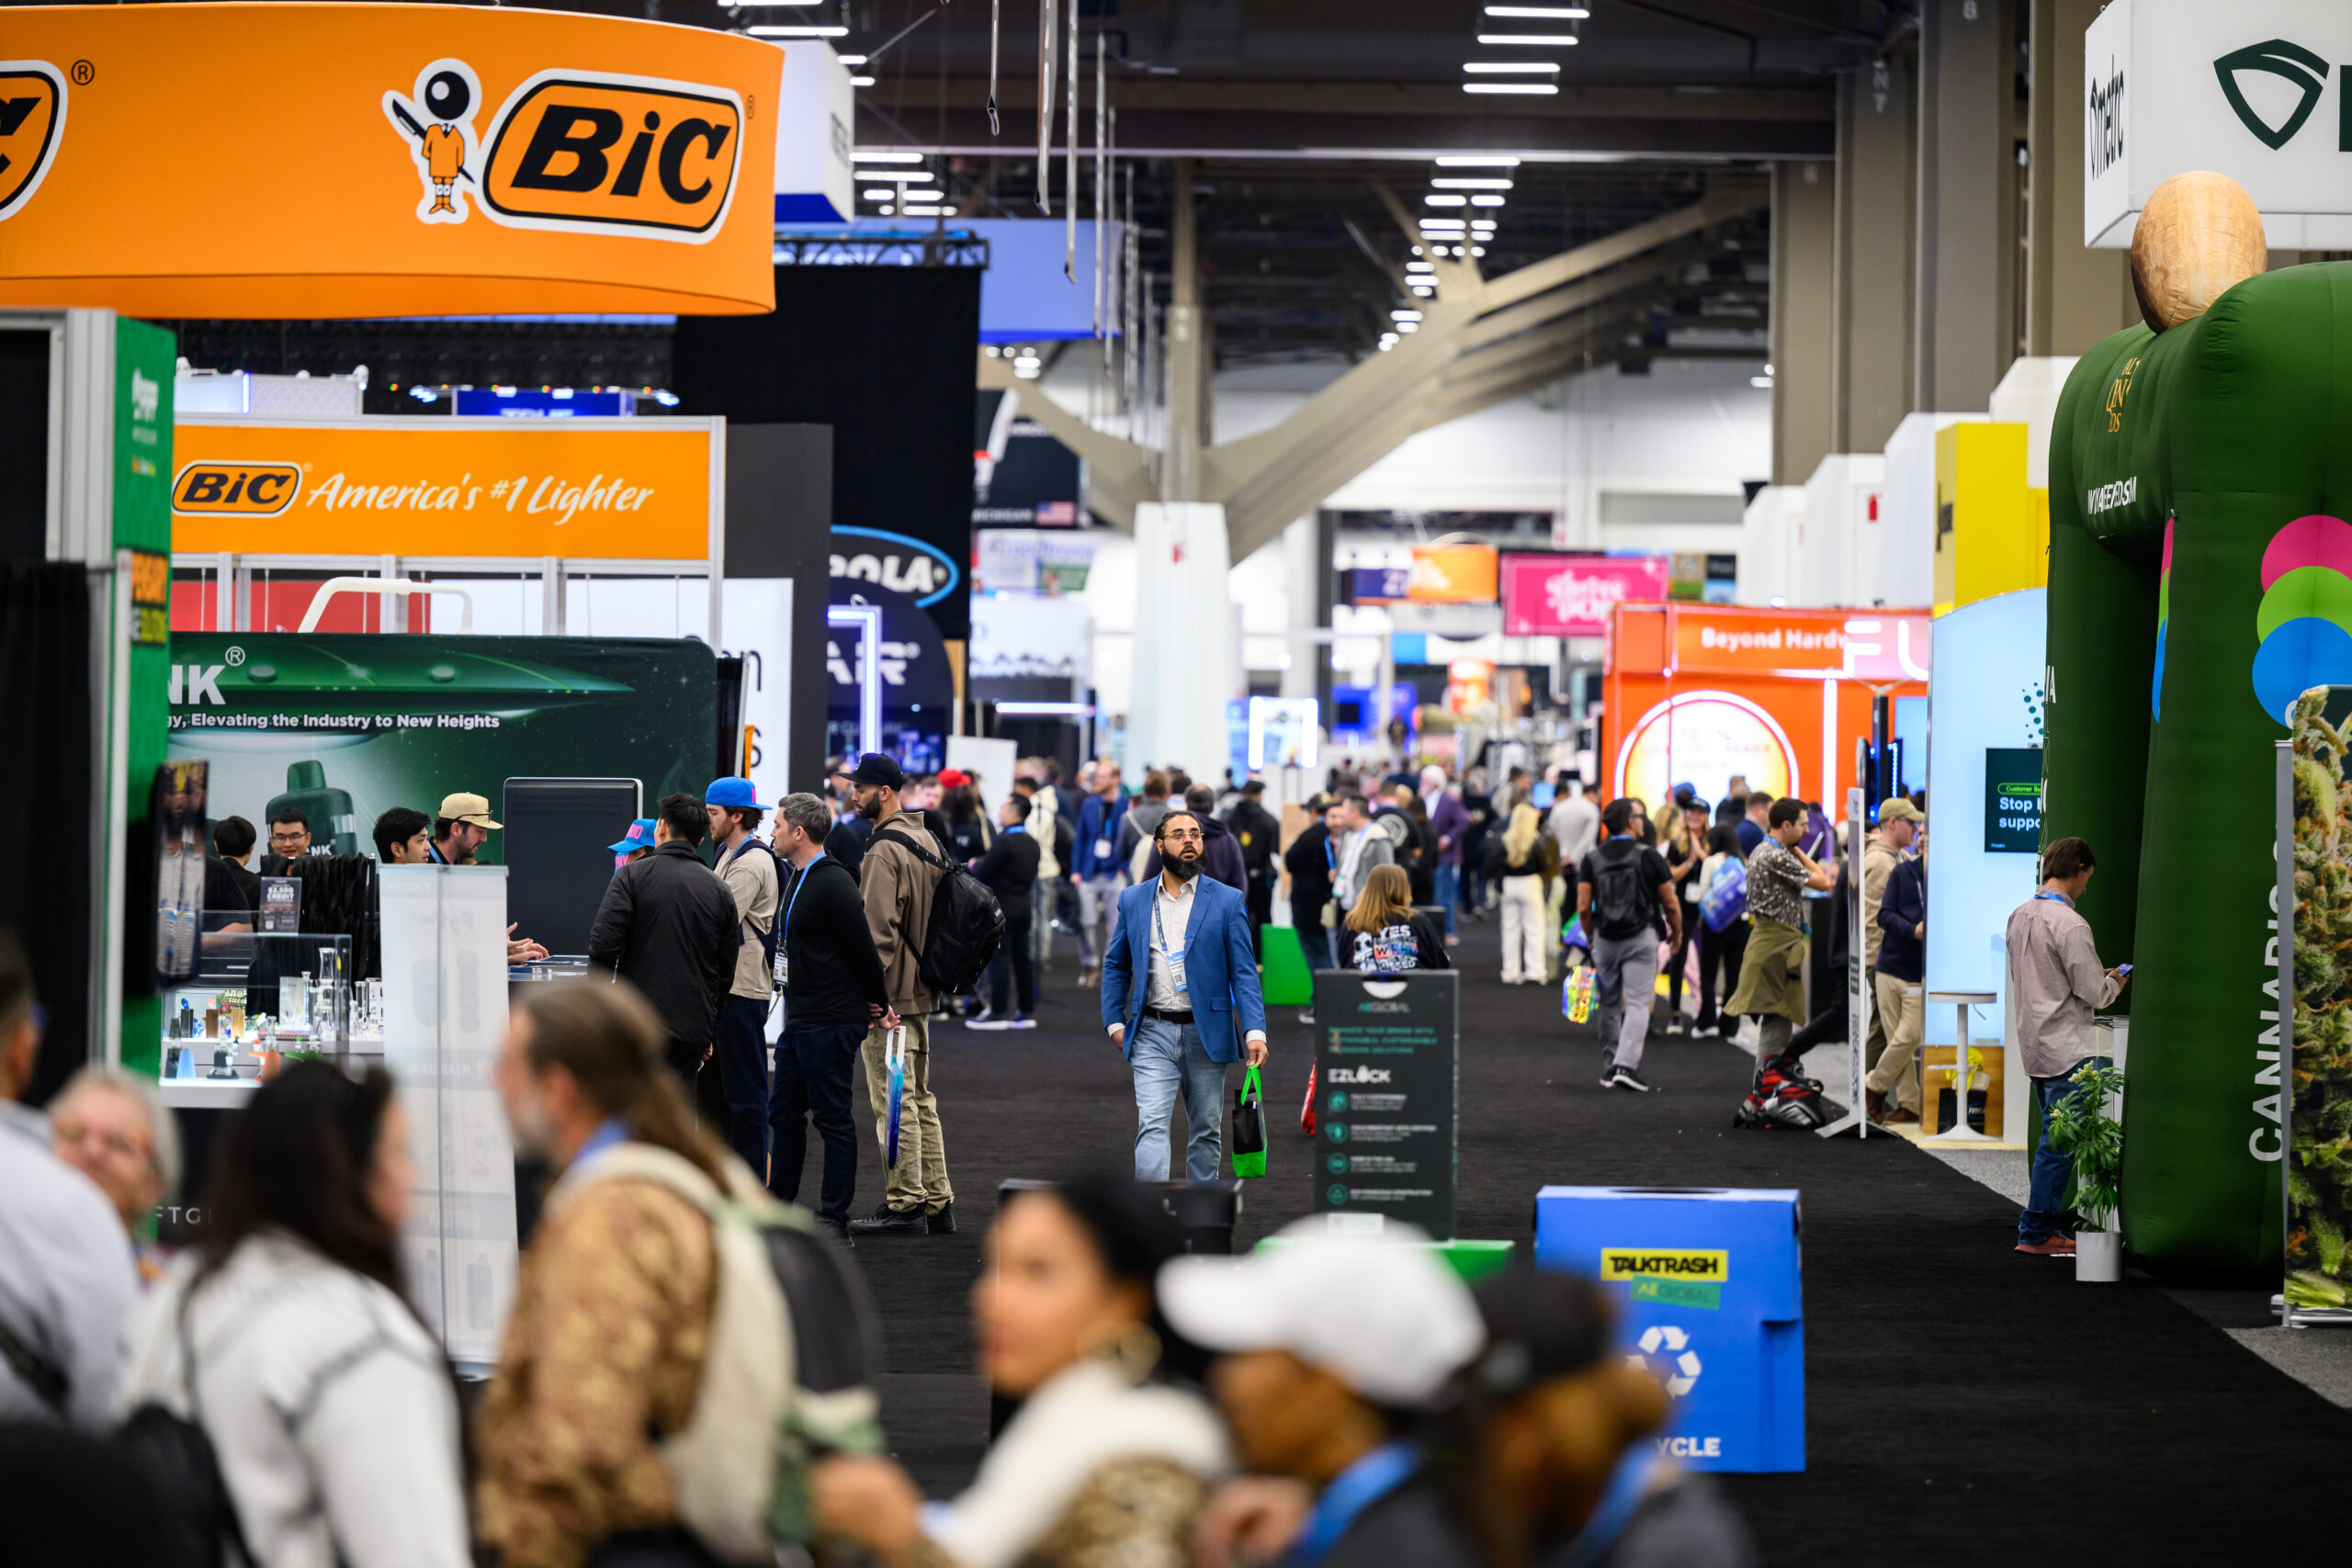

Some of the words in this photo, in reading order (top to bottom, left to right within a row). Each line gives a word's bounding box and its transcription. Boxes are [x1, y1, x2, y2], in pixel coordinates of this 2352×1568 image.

[306, 472, 482, 512] America's
[490, 476, 528, 512] #1
[526, 474, 655, 525] Lighter
[1702, 627, 1781, 653] Beyond
[191, 713, 267, 729] Elevating
[272, 713, 300, 728] the
[303, 714, 371, 729] Industry
[375, 716, 392, 728] to
[397, 714, 434, 728] New
[436, 714, 500, 730] Heights
[1999, 796, 2032, 814] Stop
[2248, 884, 2285, 1163] CANNA
[1610, 1256, 1718, 1274] TALKTRASH
